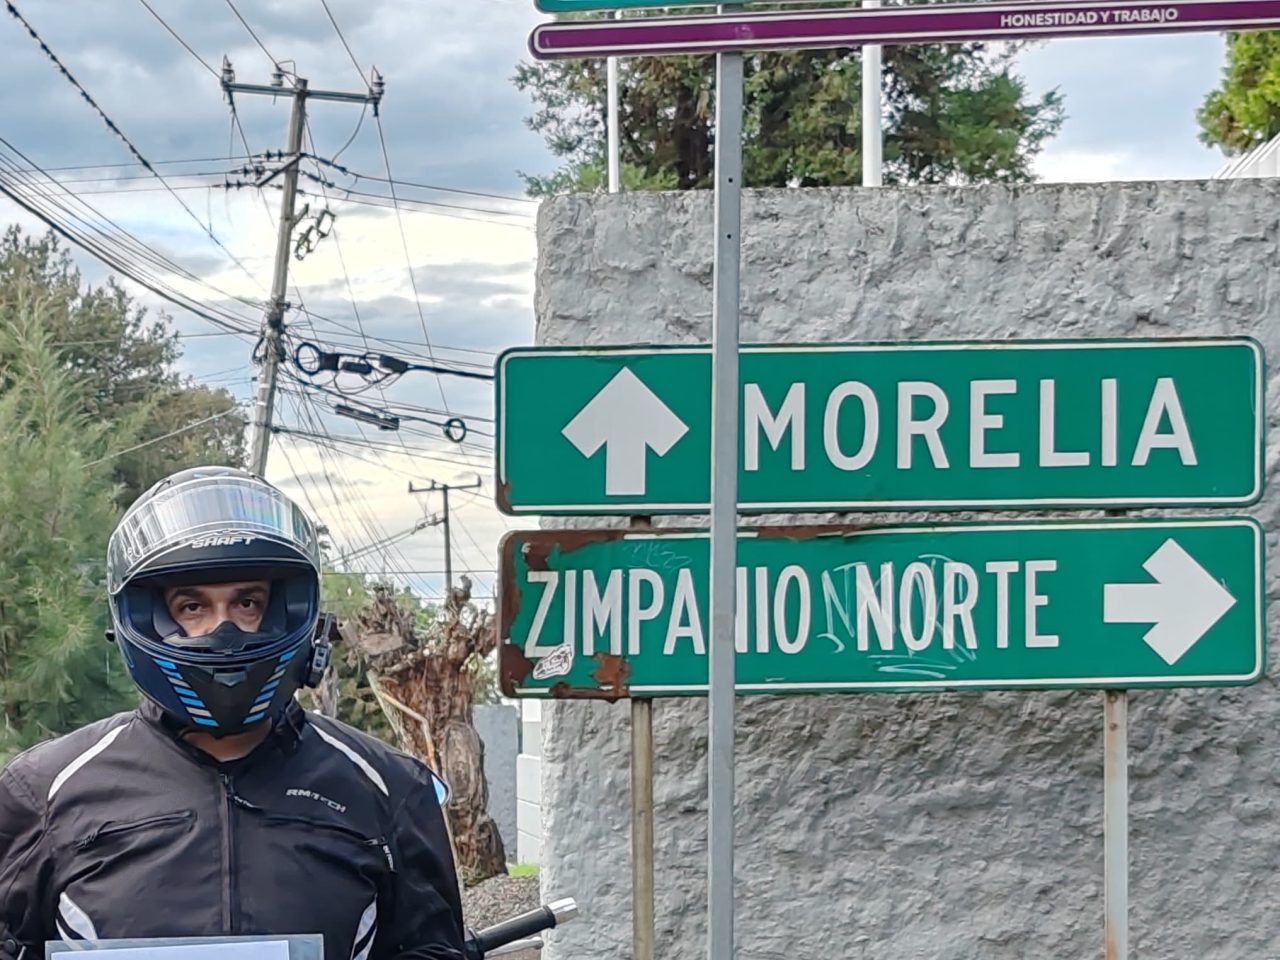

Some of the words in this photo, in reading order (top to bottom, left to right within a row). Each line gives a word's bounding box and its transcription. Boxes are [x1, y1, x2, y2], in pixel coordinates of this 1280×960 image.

[1000, 11, 1098, 28] HONESTIDAD
[1099, 11, 1110, 23] Y
[1112, 8, 1179, 23] TRABAJO
[744, 377, 1198, 472] MORELIA
[855, 560, 1060, 652] NORTE
